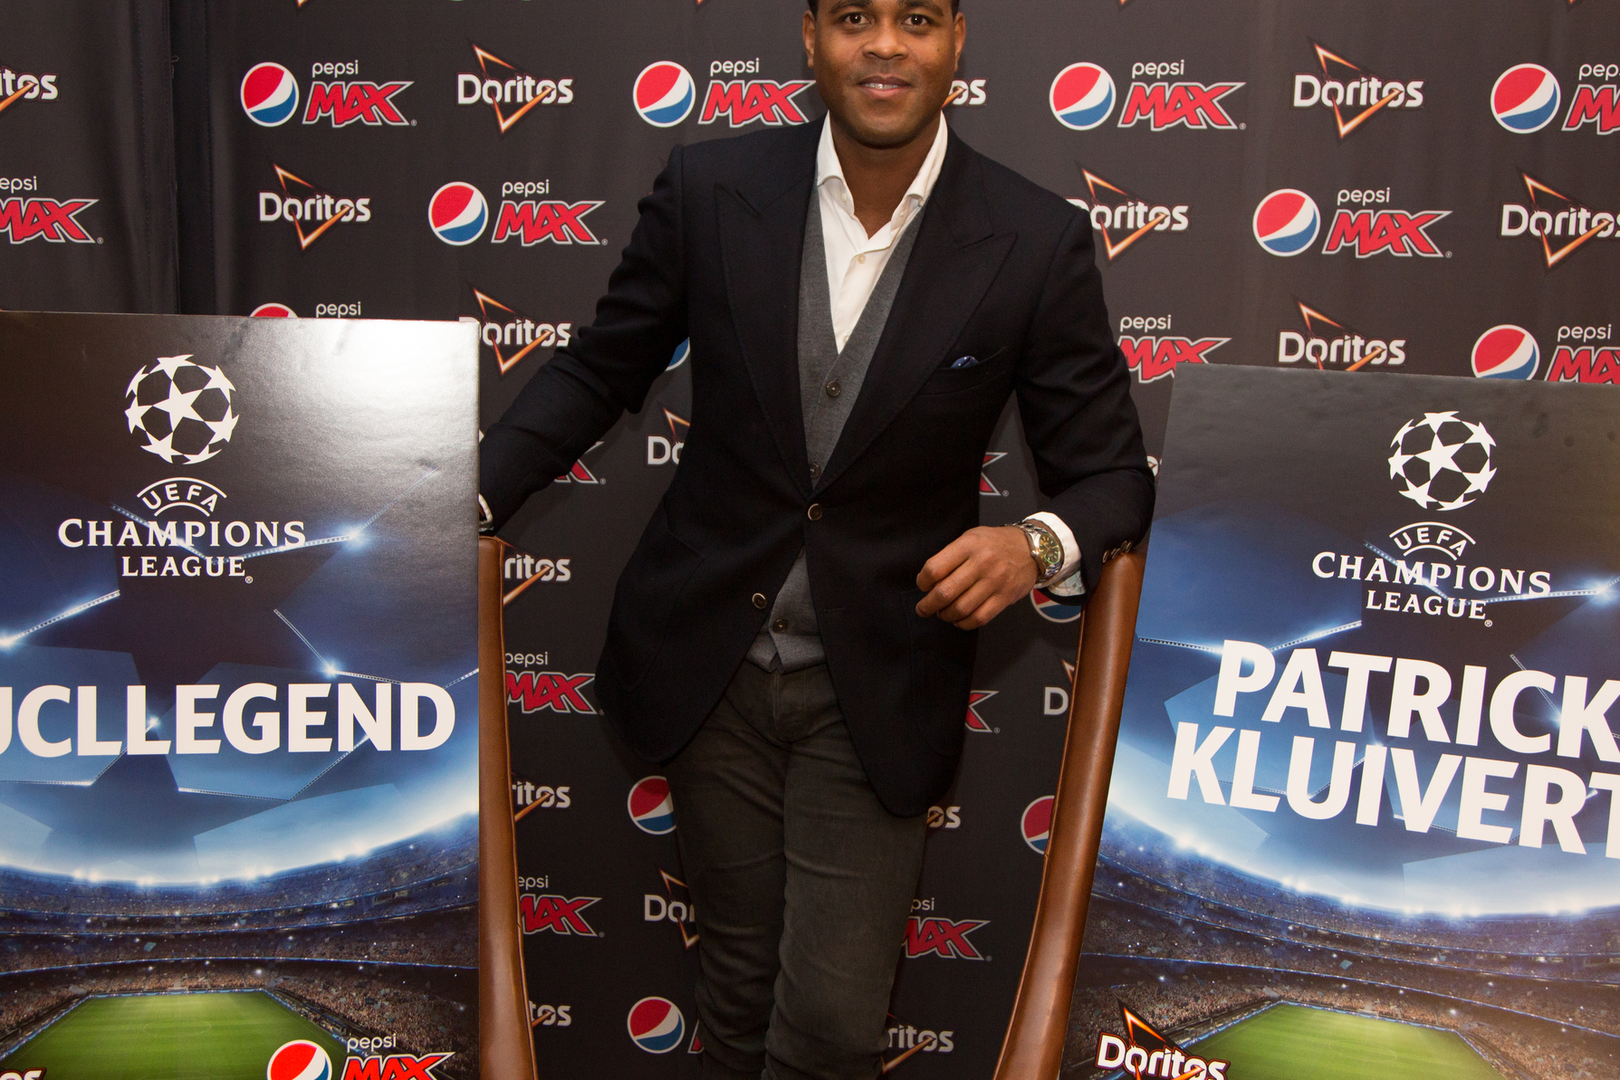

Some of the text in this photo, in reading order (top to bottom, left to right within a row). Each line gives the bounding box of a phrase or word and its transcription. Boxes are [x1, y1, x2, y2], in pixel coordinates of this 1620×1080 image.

[312, 60, 359, 77] pepsi
[710, 58, 759, 76] pepsi
[1132, 60, 1185, 79] pepsi
[1579, 63, 1620, 81] pep
[458, 73, 573, 104] Doritos
[1294, 75, 1424, 108] Doritos
[302, 81, 414, 128] MAX
[698, 80, 816, 128] MAX
[1118, 82, 1247, 131] MAX
[0, 176, 37, 193] epsi
[502, 179, 549, 197] pepsi
[1337, 187, 1390, 206] pepsi
[259, 192, 371, 223] Doritos
[1066, 199, 1189, 231] oritos
[1501, 204, 1620, 237] Dorito
[491, 201, 606, 247] MAX
[1322, 210, 1452, 258] MAX
[315, 301, 362, 318] pepsi
[1120, 314, 1172, 333] pepsi
[459, 316, 572, 347] oritos
[1557, 324, 1612, 342] pepsi
[1117, 335, 1233, 383] MAX
[1278, 331, 1406, 365] Doritos
[1545, 345, 1620, 384] MA
[142, 483, 218, 512] UEFA
[58, 519, 306, 548] CHAMPIONS
[1394, 527, 1467, 557] UEFA
[122, 556, 246, 577] LEAGUE
[504, 554, 571, 581] ritos
[1312, 551, 1552, 597] CHAMPIONS
[1366, 590, 1487, 621] LEAGUE
[505, 670, 597, 714] MAX
[1213, 639, 1620, 763] PATRICK
[0, 682, 456, 758] CLLEGEND
[512, 781, 571, 808] itos
[518, 876, 549, 890] epsi
[910, 897, 935, 912] psi
[347, 1033, 396, 1053] pepsi
[888, 1025, 954, 1052] ritos
[341, 1052, 456, 1080] MAX
[1097, 1035, 1227, 1080] Doritos
